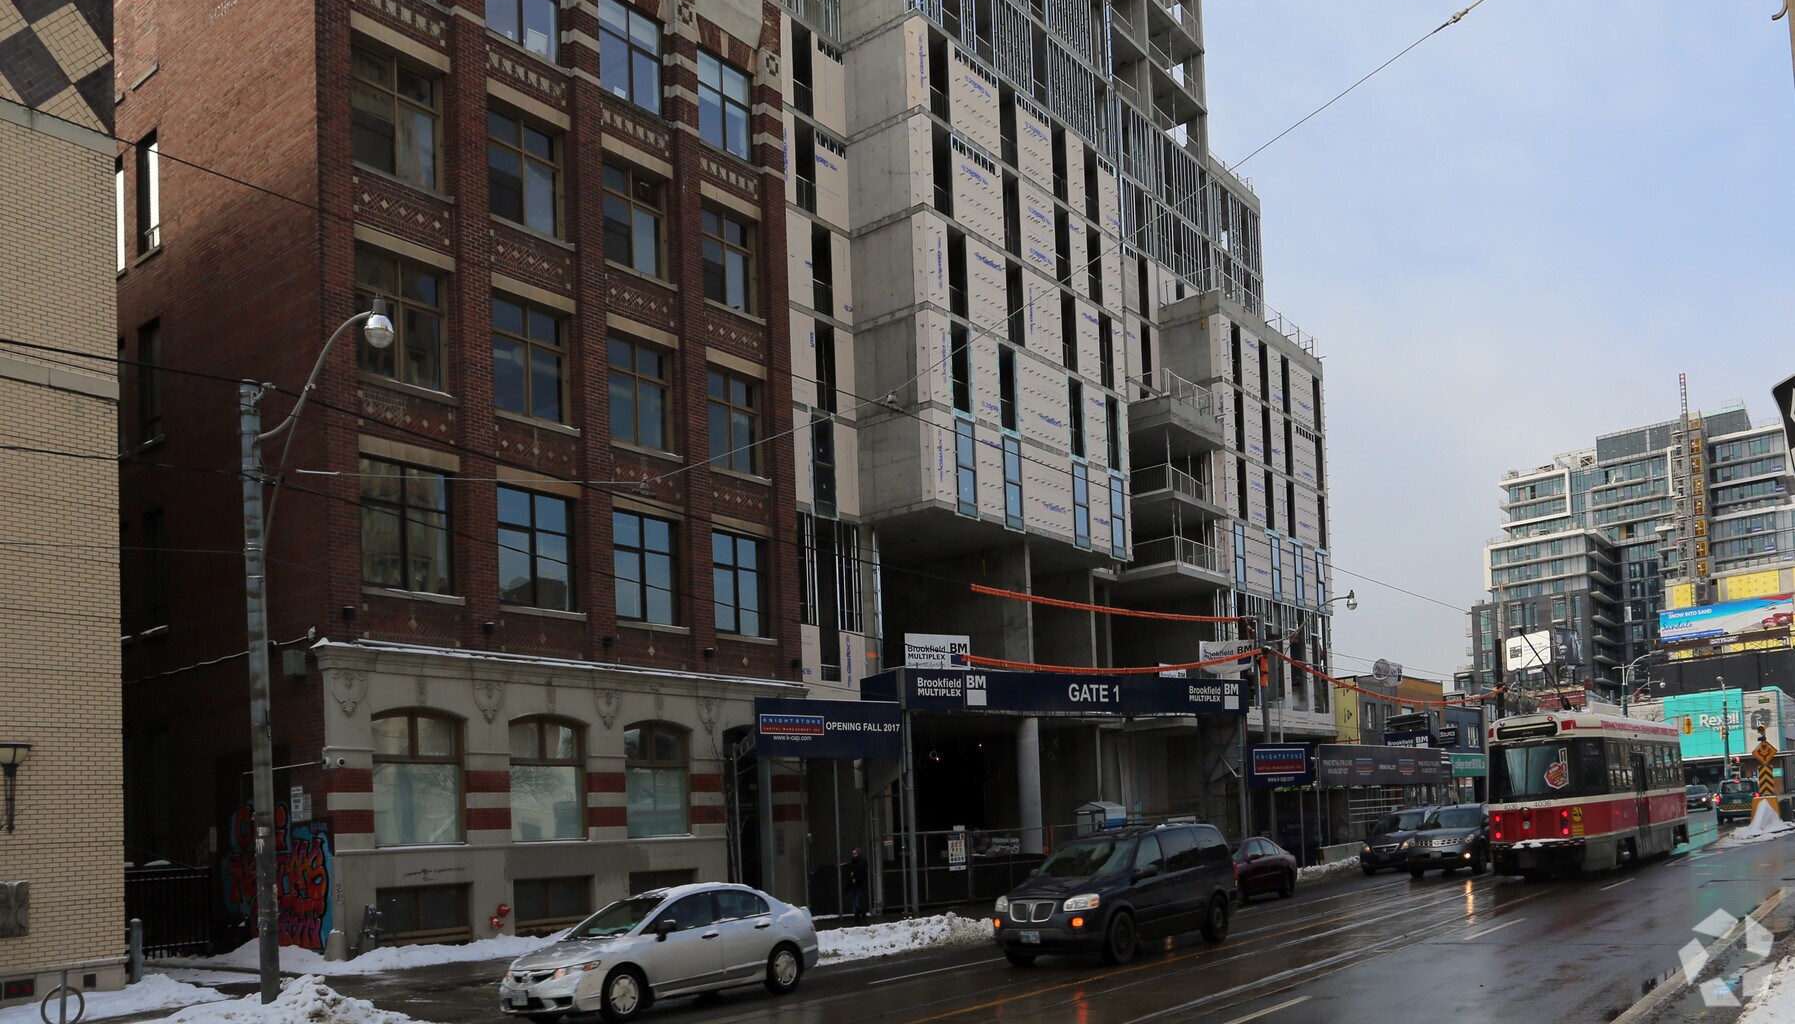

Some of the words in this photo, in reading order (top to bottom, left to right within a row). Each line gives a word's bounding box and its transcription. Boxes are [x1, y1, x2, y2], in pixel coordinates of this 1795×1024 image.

[1668, 611, 1684, 619] SNOW
[1685, 609, 1698, 617] INTO
[1662, 620, 1692, 631] Sandals
[908, 645, 945, 653] Brookfield
[949, 643, 967, 654] BM
[1237, 645, 1252, 654] BM
[917, 677, 961, 688] Brookfield
[966, 675, 986, 688] BM
[917, 688, 961, 696] MULTIPLEX
[1068, 684, 1109, 702] GATE
[1113, 685, 1120, 702] 1
[1189, 685, 1220, 694] Brookfield
[1224, 684, 1239, 695] BM
[826, 722, 861, 731] OPENING
[863, 723, 882, 731] FALL
[884, 724, 900, 732] 2017
